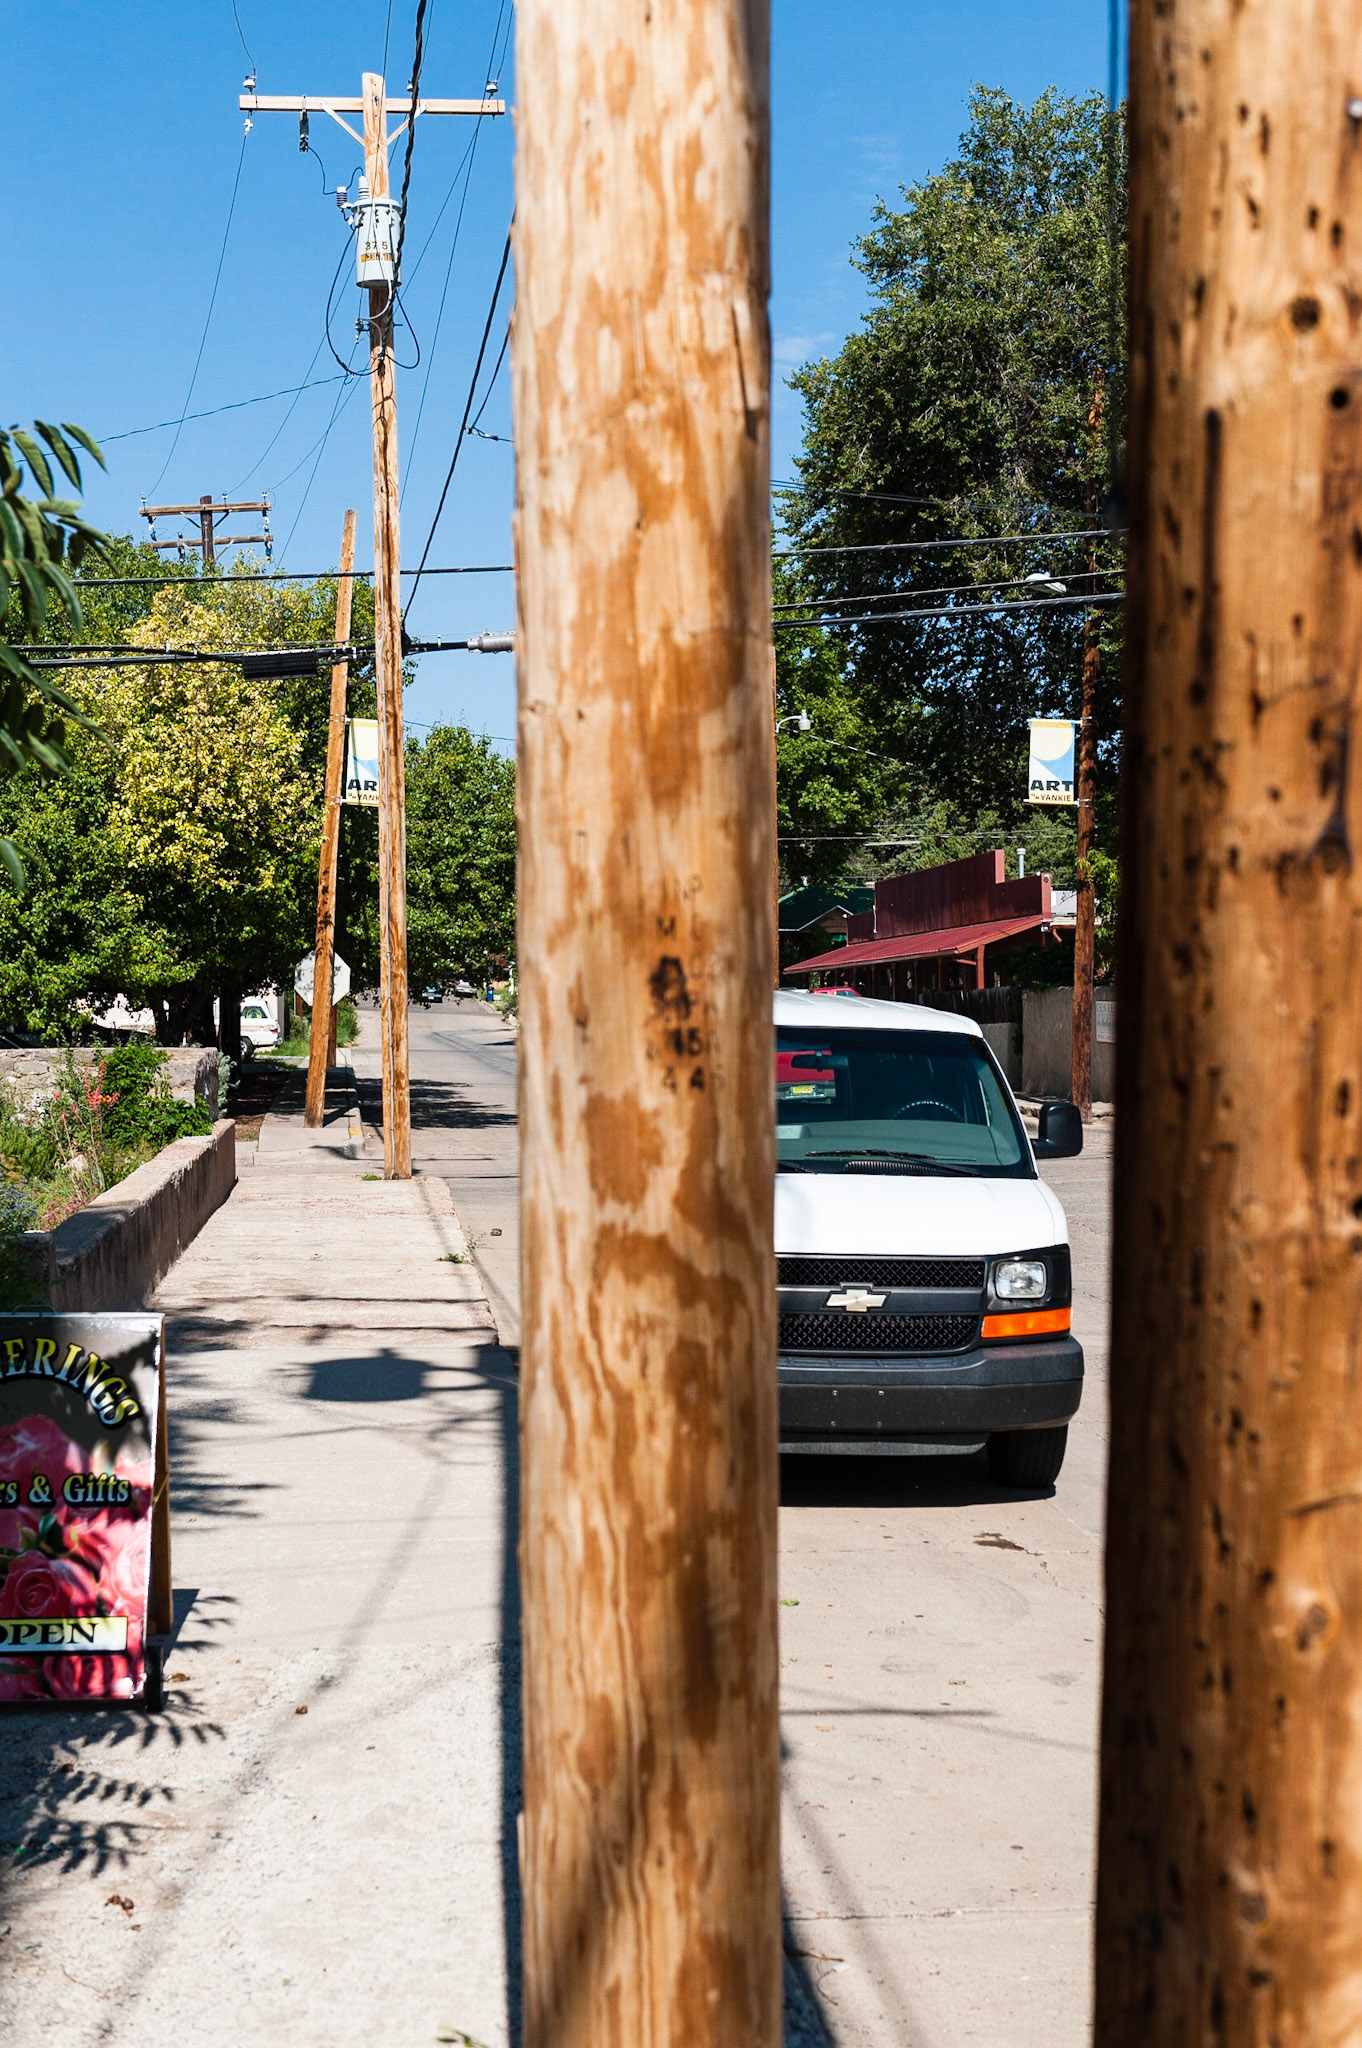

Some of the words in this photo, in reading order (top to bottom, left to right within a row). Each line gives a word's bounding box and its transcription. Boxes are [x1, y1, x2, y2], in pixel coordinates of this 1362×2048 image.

[348, 779, 378, 791] AR
[1031, 780, 1073, 791] ART
[357, 793, 380, 802] YANK
[1041, 794, 1072, 802] YANKIE
[0, 1337, 140, 1425] ERINGS
[29, 1475, 52, 1503] &
[63, 1474, 130, 1503] Gifts
